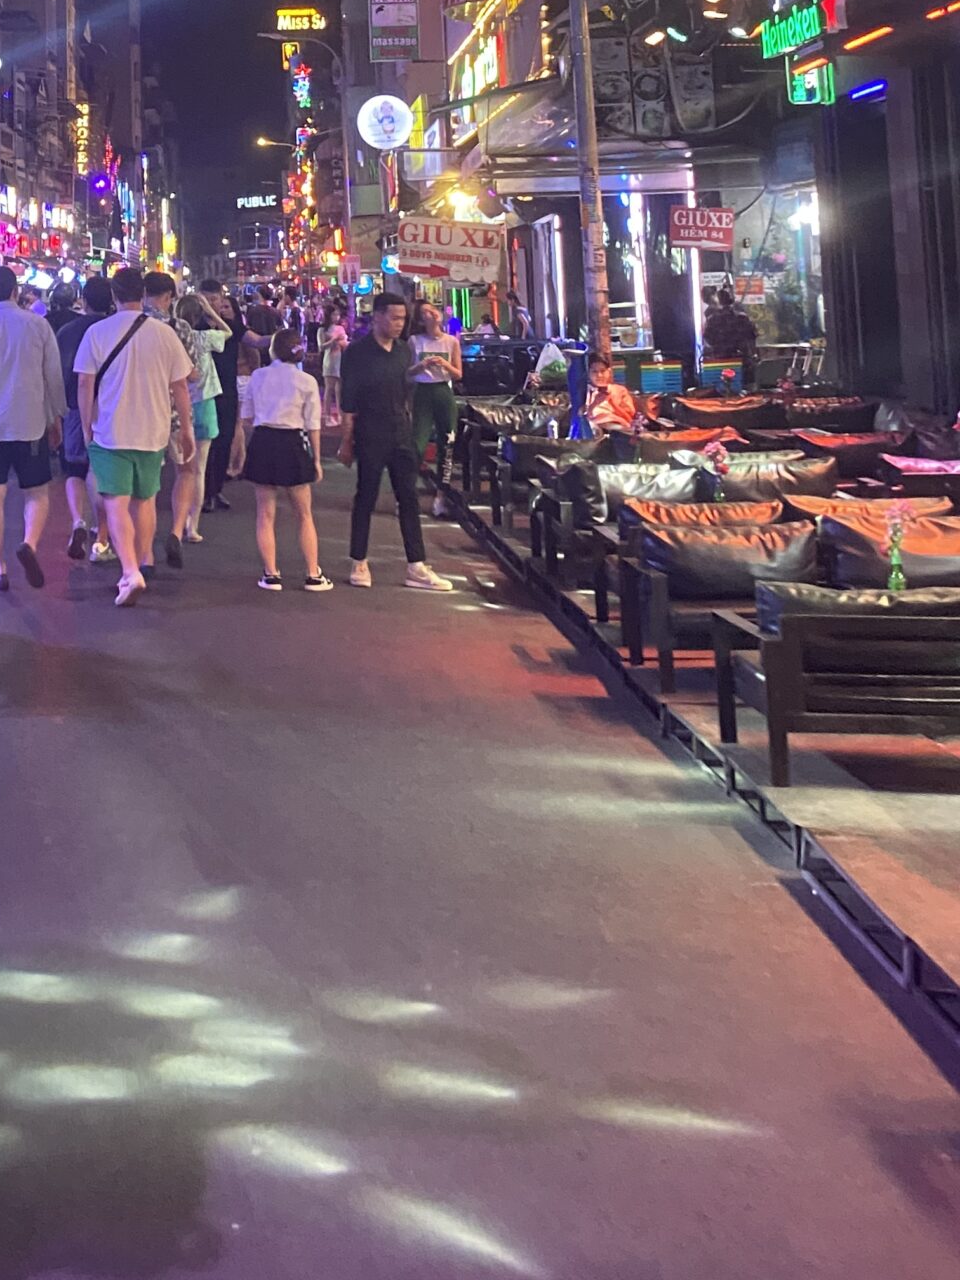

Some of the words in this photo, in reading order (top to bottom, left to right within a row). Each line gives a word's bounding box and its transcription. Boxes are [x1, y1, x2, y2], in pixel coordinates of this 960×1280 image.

[761, 4, 822, 60] Heineken
[236, 195, 278, 209] PUBLIC
[460, 227, 501, 250] XE
[710, 230, 724, 239] 84
